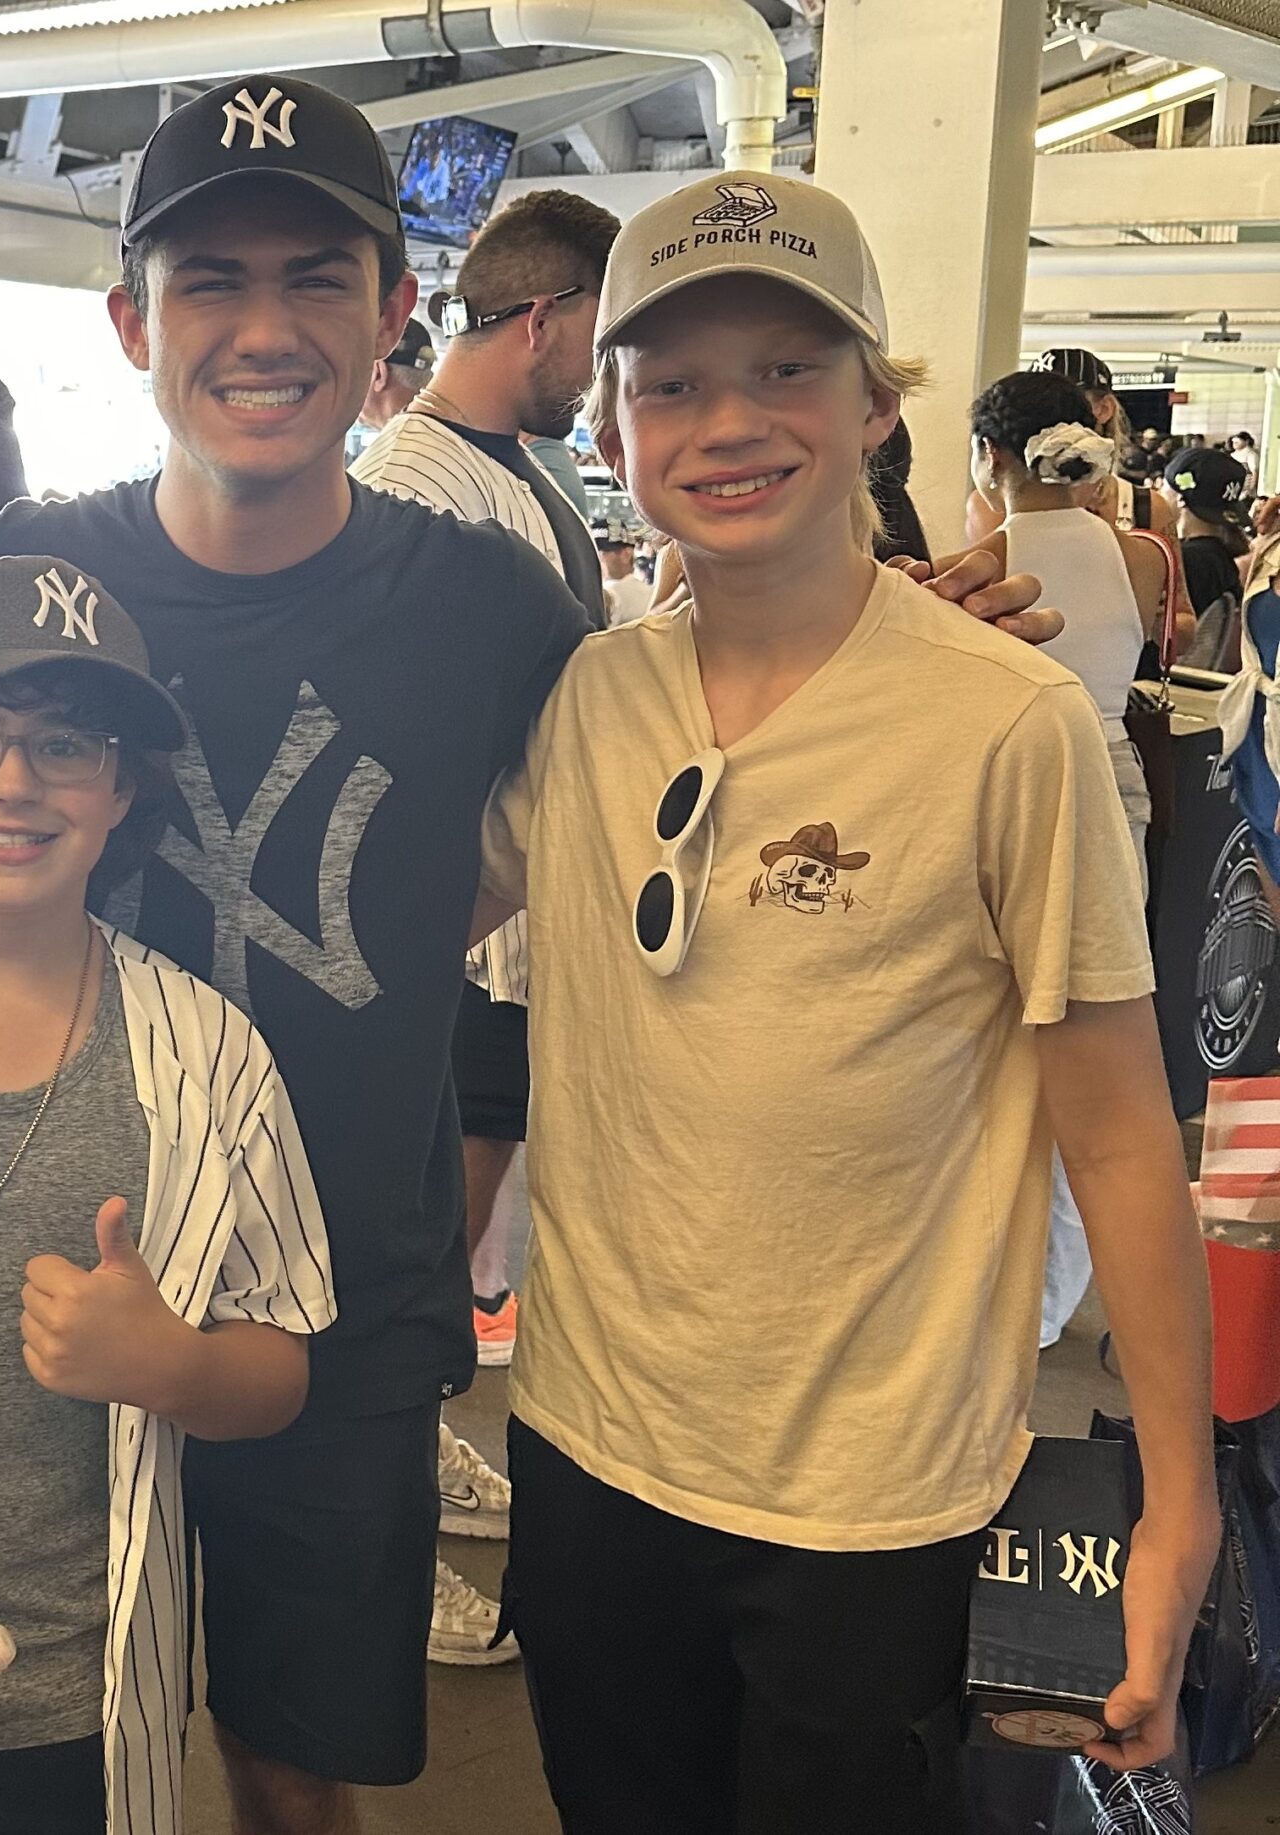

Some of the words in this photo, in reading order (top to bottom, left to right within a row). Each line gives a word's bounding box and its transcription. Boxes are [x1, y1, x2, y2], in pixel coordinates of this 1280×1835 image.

[221, 87, 297, 149] NY
[650, 237, 688, 267] SIDE
[694, 226, 761, 249] PORCH
[770, 230, 817, 259] PIZZA
[32, 567, 99, 646] NY
